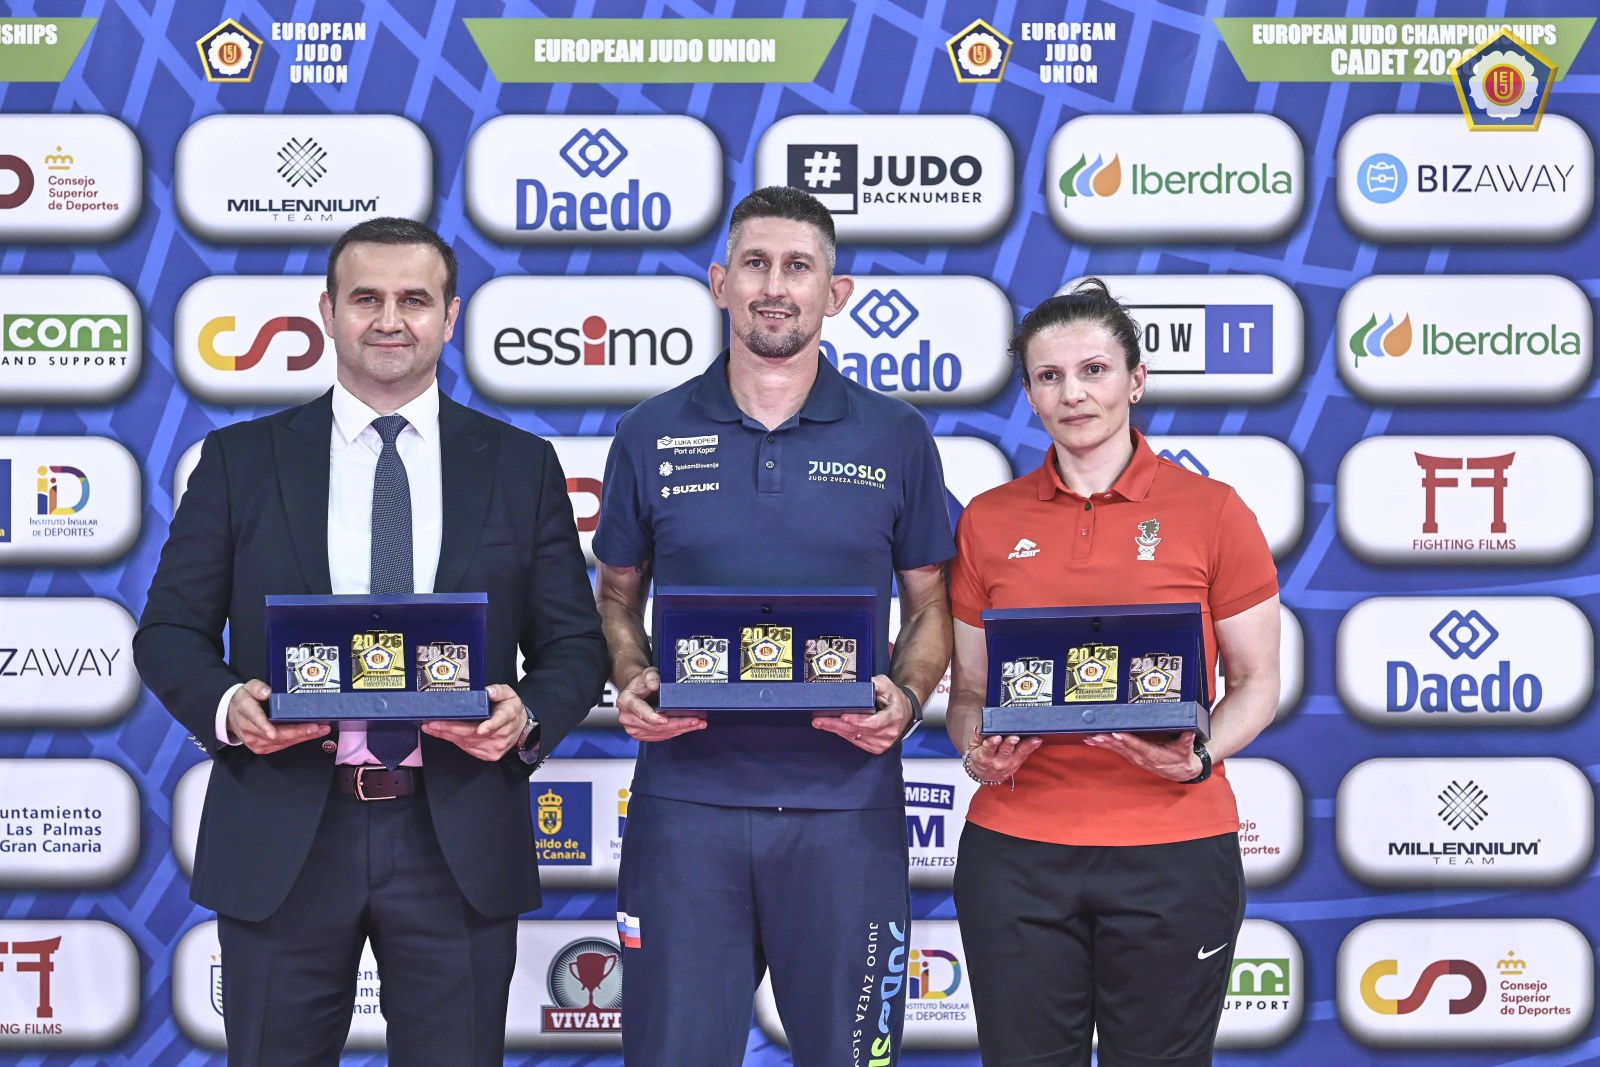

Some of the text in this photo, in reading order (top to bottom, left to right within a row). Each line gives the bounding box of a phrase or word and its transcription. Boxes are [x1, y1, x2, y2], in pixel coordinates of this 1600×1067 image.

[0, 23, 57, 45] SHIPS
[272, 22, 366, 41] EUROPEAN
[1021, 22, 1116, 41] EUROPEAN
[1252, 24, 1347, 45] EUROPEAN
[1350, 24, 1397, 45] JUDO
[295, 43, 342, 62] JUDO
[534, 38, 776, 62] EUROPEAN JUDO UNION
[1045, 44, 1092, 62] JUDO
[1331, 48, 1408, 75] CADET
[289, 64, 348, 83] UNION
[1040, 64, 1098, 83] UNION
[862, 155, 982, 186] JUDO
[48, 175, 96, 188] Consejo
[1132, 163, 1292, 195] Iberdrola
[1418, 164, 1575, 193] BIZAWAY
[48, 187, 98, 201] Superior
[863, 192, 982, 204] BACKNUMBER
[48, 199, 119, 212] de Deportes
[227, 198, 377, 212] MILLENNIUM
[516, 178, 671, 232] Daedo
[272, 213, 334, 222] TEAM
[493, 316, 693, 367] essimo
[1223, 322, 1255, 353] IT
[1423, 324, 1581, 356] Iberdrola
[1, 356, 127, 366] AND SUPPORT
[693, 437, 716, 445] KOPER
[697, 447, 716, 455] Koper
[672, 482, 720, 495] SUZUKI
[854, 479, 885, 489] SLOVENIJE
[44, 528, 94, 537] DEPORTES
[1413, 538, 1516, 551] FIGHTING FILMS
[1387, 660, 1543, 713] Daedo
[7, 822, 102, 836] Las Palmas
[0, 839, 102, 853] Gran Canaria
[564, 838, 579, 849] de
[1389, 842, 1538, 855] MILLENNIUM
[543, 850, 587, 859] Canaria
[909, 856, 955, 867] THLETES
[1433, 857, 1495, 865] TEAM
[866, 922, 878, 967] JUDO
[1500, 980, 1547, 993] Consejo
[855, 975, 874, 1023] ZVEZA
[1501, 992, 1551, 1005] Superior
[916, 1012, 966, 1021] DEPORTES
[1500, 1004, 1571, 1017] de Deportes
[25, 1024, 62, 1035] FILMS
